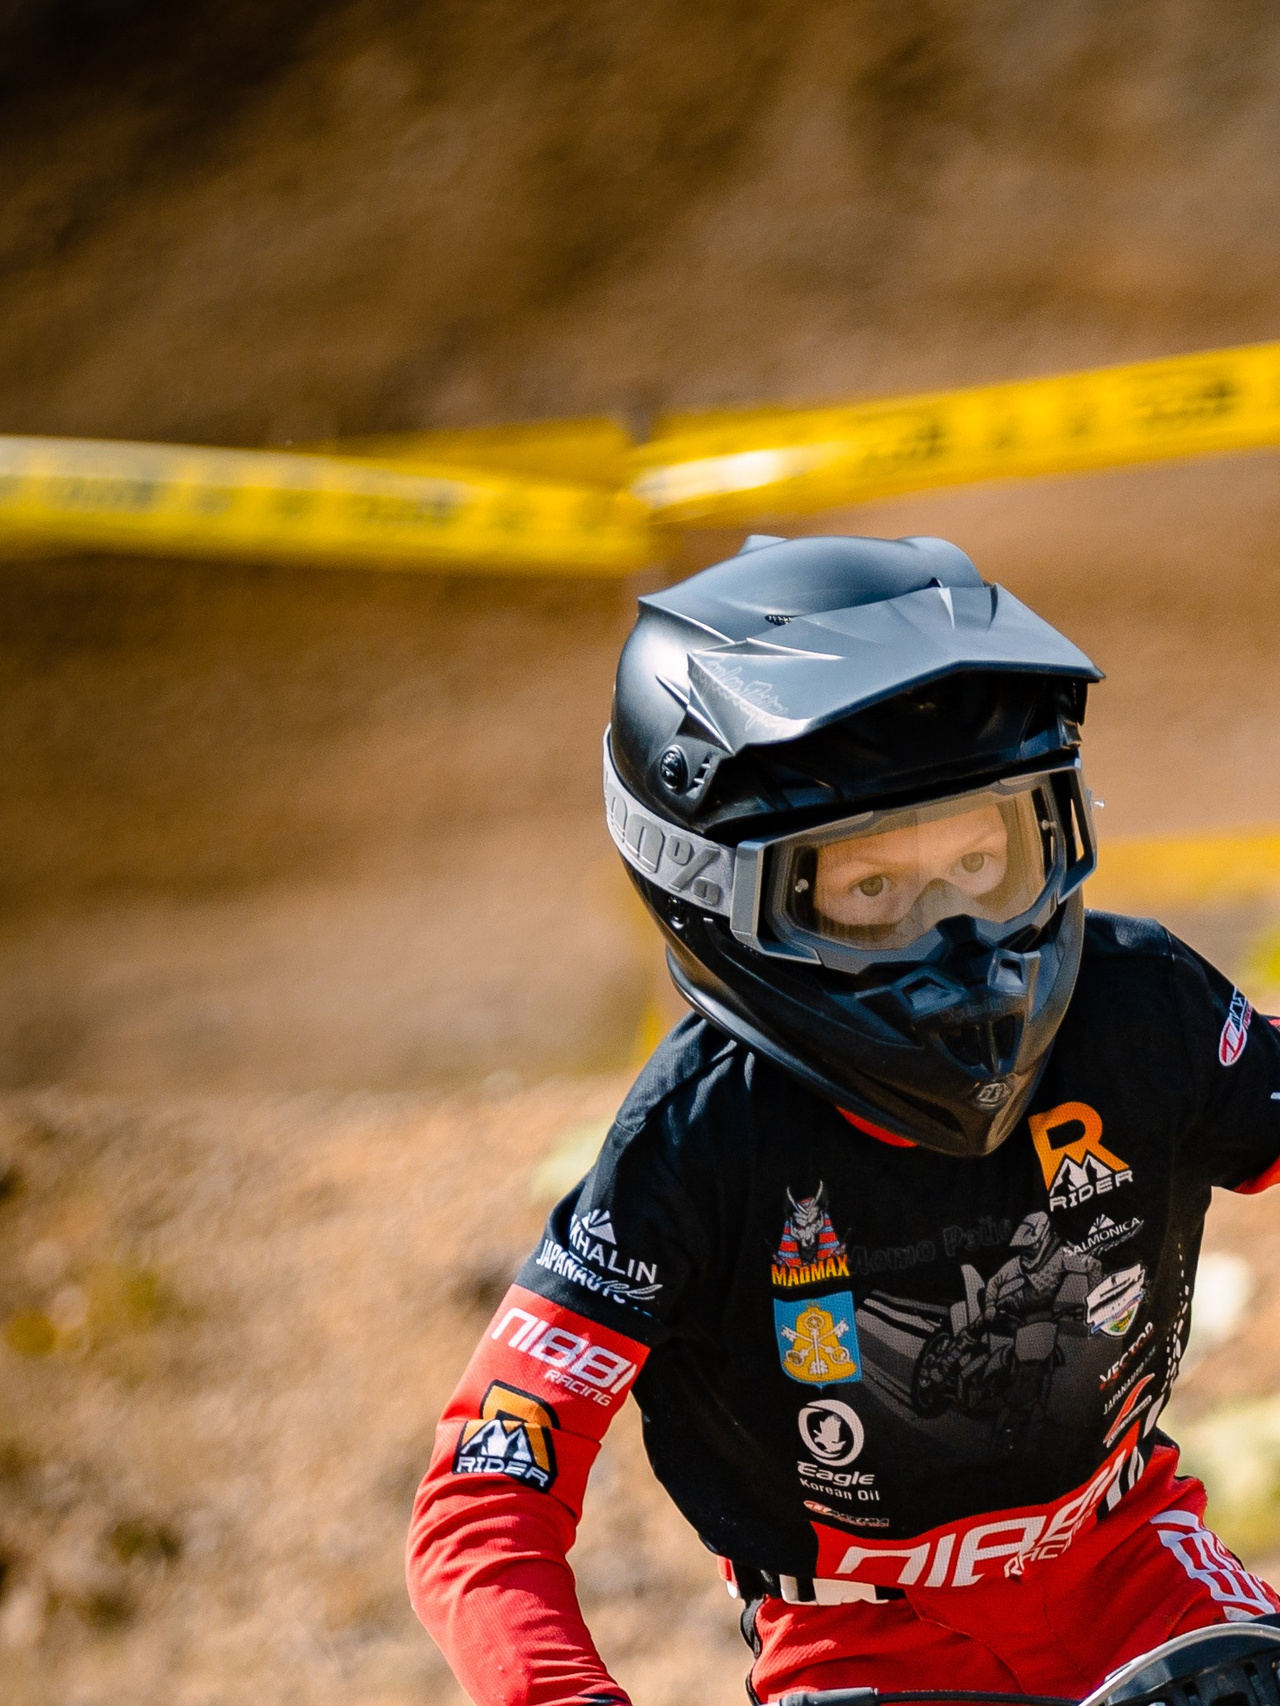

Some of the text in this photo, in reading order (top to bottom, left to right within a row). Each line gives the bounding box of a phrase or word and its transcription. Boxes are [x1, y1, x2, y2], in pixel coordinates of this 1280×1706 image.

[1049, 1169, 1134, 1212] RIDER
[771, 1253, 850, 1287] MADMAX
[543, 1368, 614, 1408] RACING
[456, 1456, 549, 1488] RIDER
[797, 1460, 876, 1488] Eagle
[799, 1477, 880, 1502] Korean Oil
